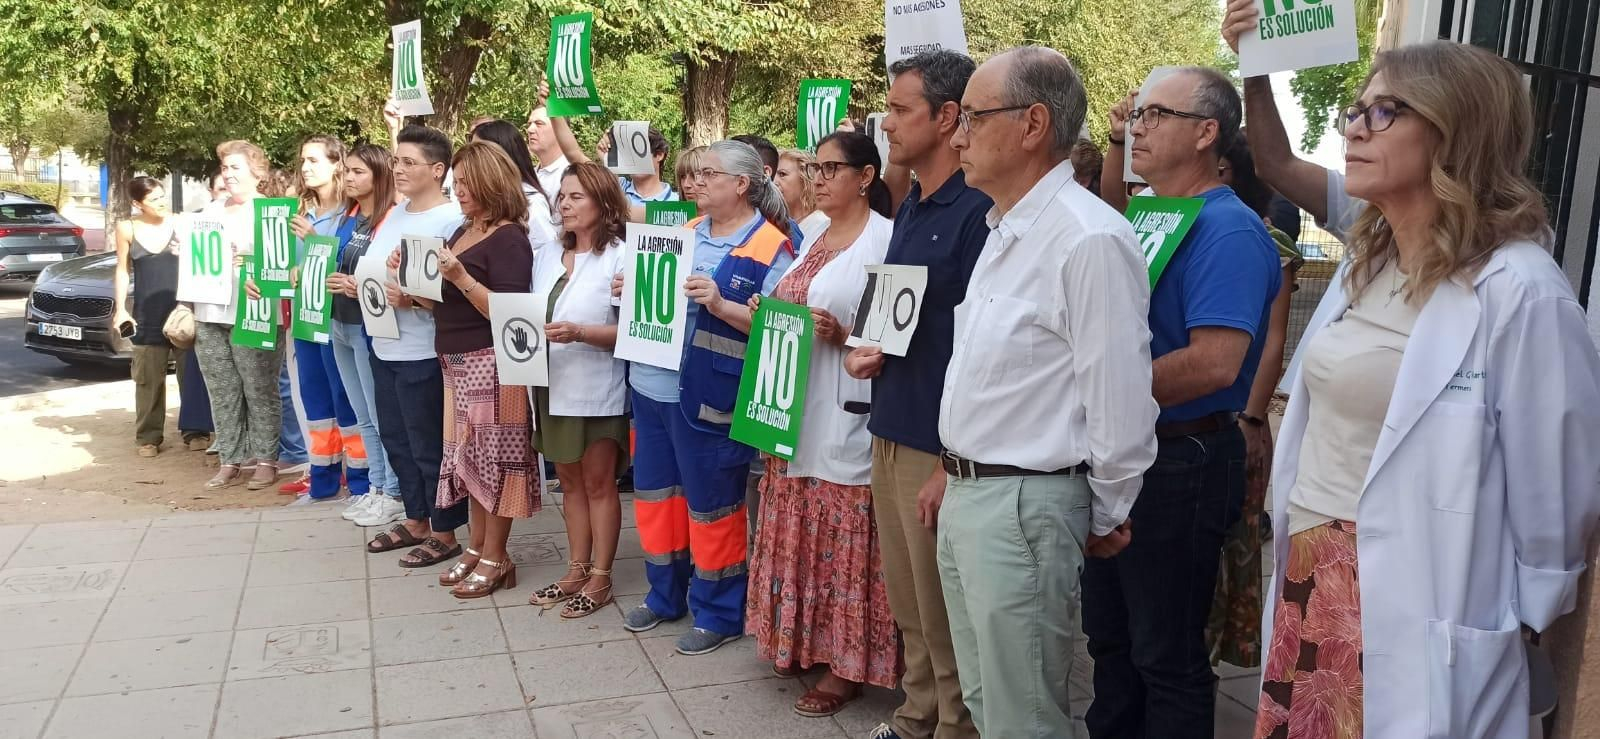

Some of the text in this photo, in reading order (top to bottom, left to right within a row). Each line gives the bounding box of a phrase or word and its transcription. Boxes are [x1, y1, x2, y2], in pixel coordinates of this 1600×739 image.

[1259, 18, 1274, 40] ES
[1275, 2, 1334, 37] SOLUCIÓN
[397, 40, 417, 90] NO
[554, 32, 584, 88] NO
[807, 87, 817, 98] LA
[806, 96, 837, 147] NO
[653, 208, 688, 225] LA AGRESIÓN
[1138, 209, 1184, 234] AGRESIÓN
[191, 231, 223, 276] NO
[262, 217, 289, 270] NO
[637, 234, 683, 256] LA AGRESIÓN
[301, 254, 328, 310] NO
[634, 252, 677, 325] NO
[629, 320, 674, 344] ES SOLUCIÓN
[764, 309, 805, 336] LA AGRESIÓN
[753, 328, 799, 410] NO
[746, 401, 791, 431] ES SOLUCIÓN
